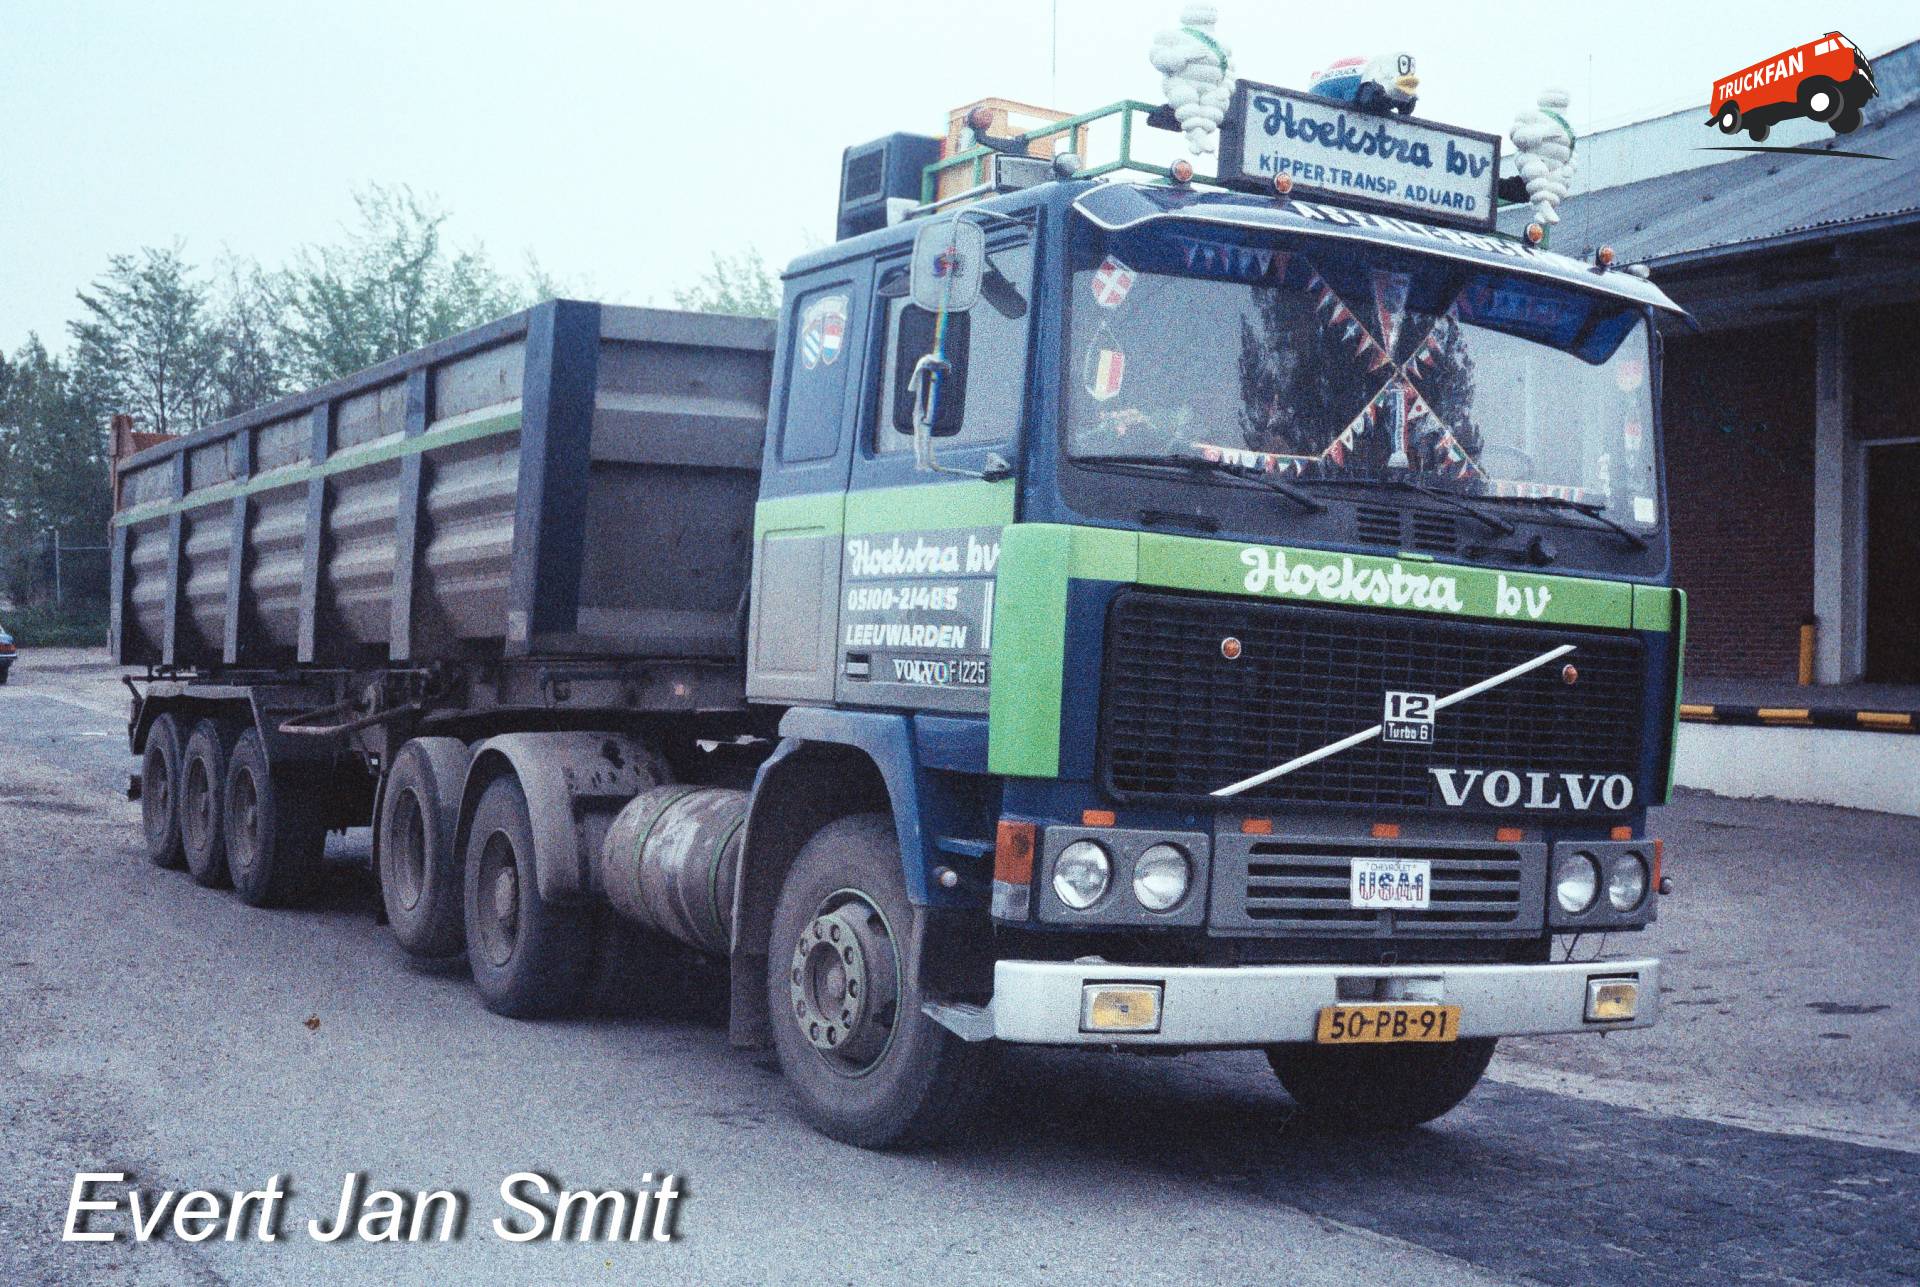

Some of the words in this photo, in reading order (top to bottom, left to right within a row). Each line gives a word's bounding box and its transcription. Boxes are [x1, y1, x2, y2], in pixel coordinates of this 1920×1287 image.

[1254, 96, 1432, 168] Hoekstra
[1446, 140, 1489, 178] bv
[1405, 184, 1476, 212] ADUARD
[847, 536, 960, 576] Hoekstra
[966, 534, 1000, 573] bv
[1240, 548, 1463, 611] Hoekstra
[1496, 575, 1551, 618] bv
[845, 624, 967, 649] LEEUWARDEN
[893, 658, 948, 684] VOLVO
[1391, 694, 1429, 719] 12
[1388, 722, 1417, 739] Turbo
[1420, 724, 1429, 740] 6
[1429, 767, 1634, 811] VOLVO
[1330, 1010, 1448, 1040] 50-PB-91
